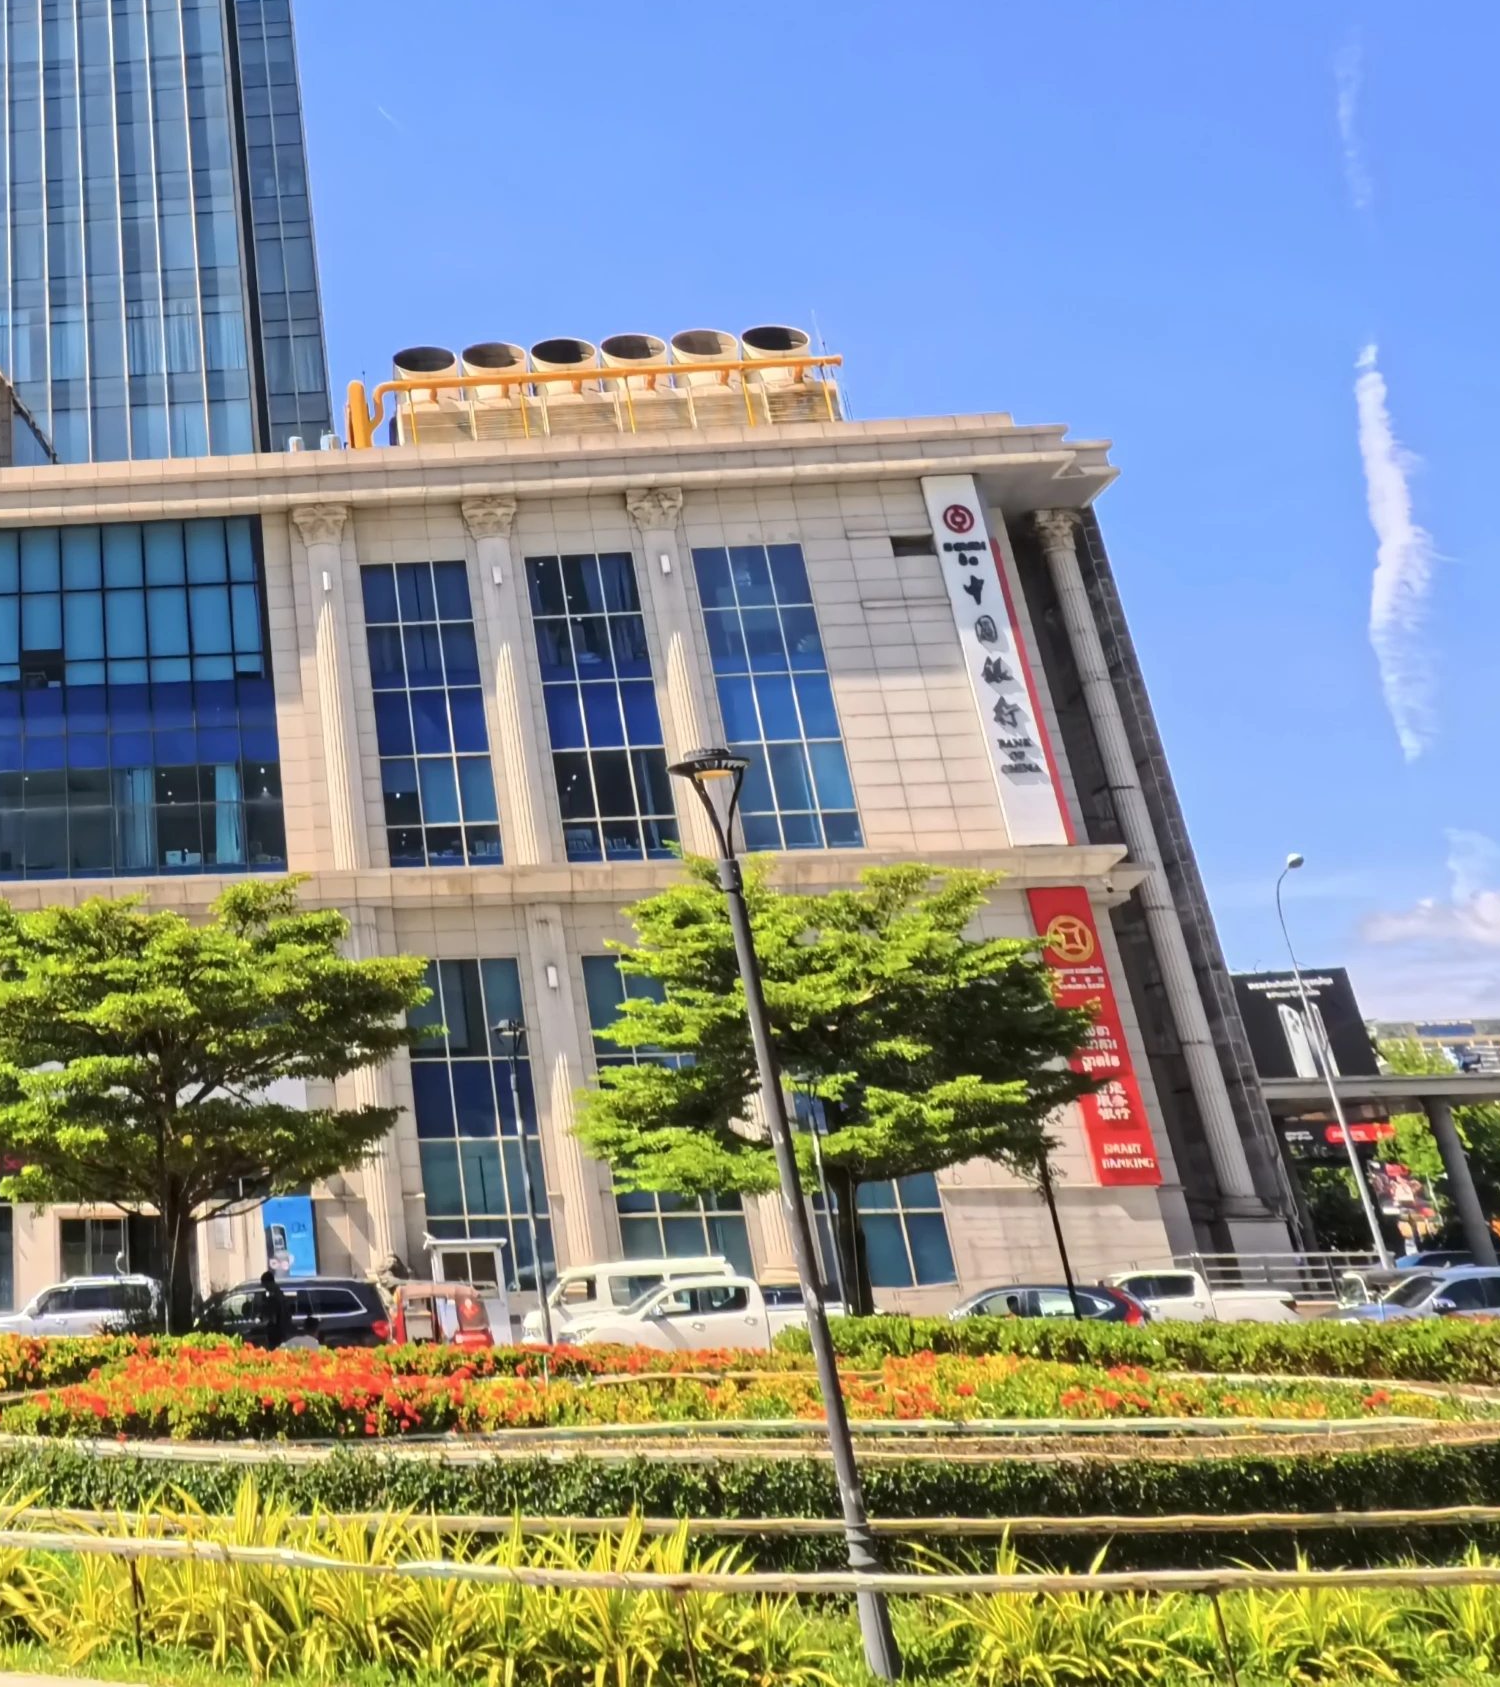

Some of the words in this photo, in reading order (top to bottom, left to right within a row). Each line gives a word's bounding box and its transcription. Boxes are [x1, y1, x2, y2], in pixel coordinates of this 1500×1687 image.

[997, 737, 1033, 748] BANK
[1008, 750, 1025, 761] OF
[1001, 763, 1042, 774] CHINA
[1101, 1157, 1155, 1169] BANKING
